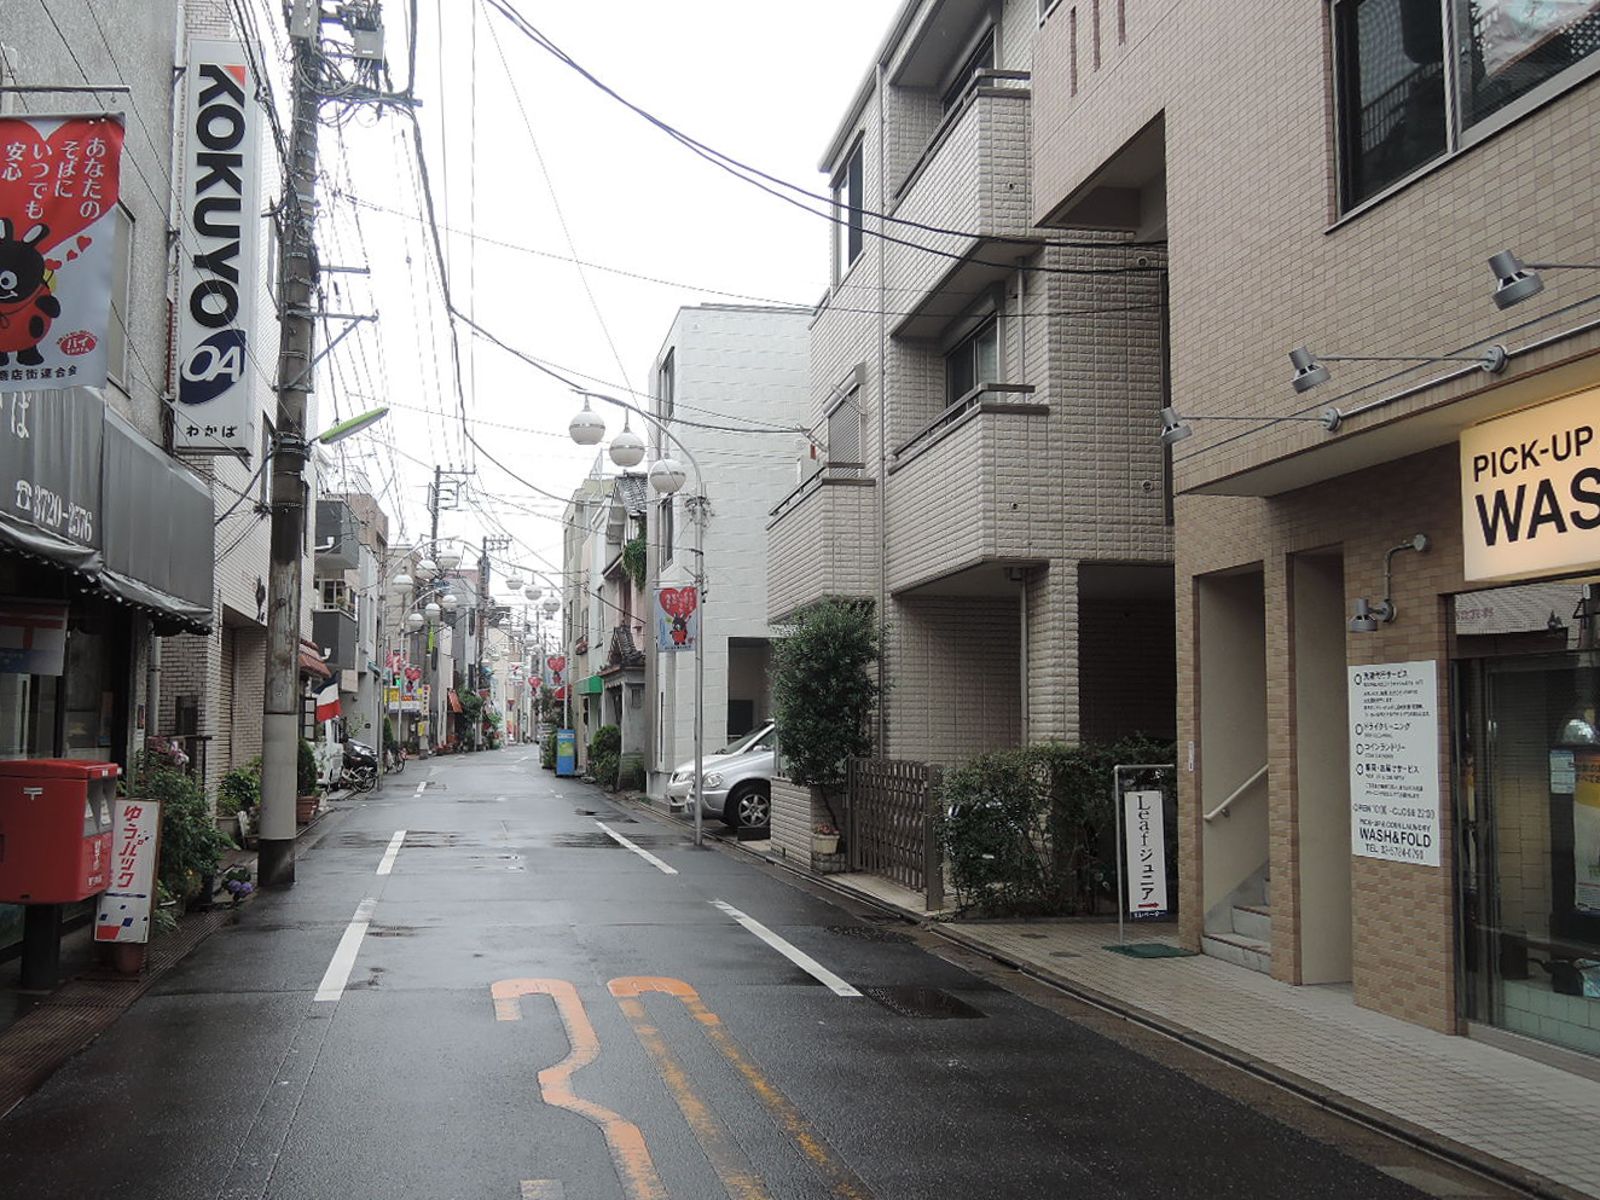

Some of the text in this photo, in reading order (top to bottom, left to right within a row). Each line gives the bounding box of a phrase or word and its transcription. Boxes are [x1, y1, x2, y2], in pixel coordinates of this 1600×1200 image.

[1, 141, 27, 181] 安心
[25, 143, 53, 219] いつでも
[55, 140, 80, 197] そばに
[80, 137, 106, 218] あなたの
[189, 64, 245, 328] KOKUYO
[181, 345, 241, 383] OA
[186, 425, 238, 438] わかば
[1473, 425, 1594, 482] PICK-UP
[1475, 467, 1600, 546] WAS
[1360, 827, 1431, 848] WASH&FOLD
